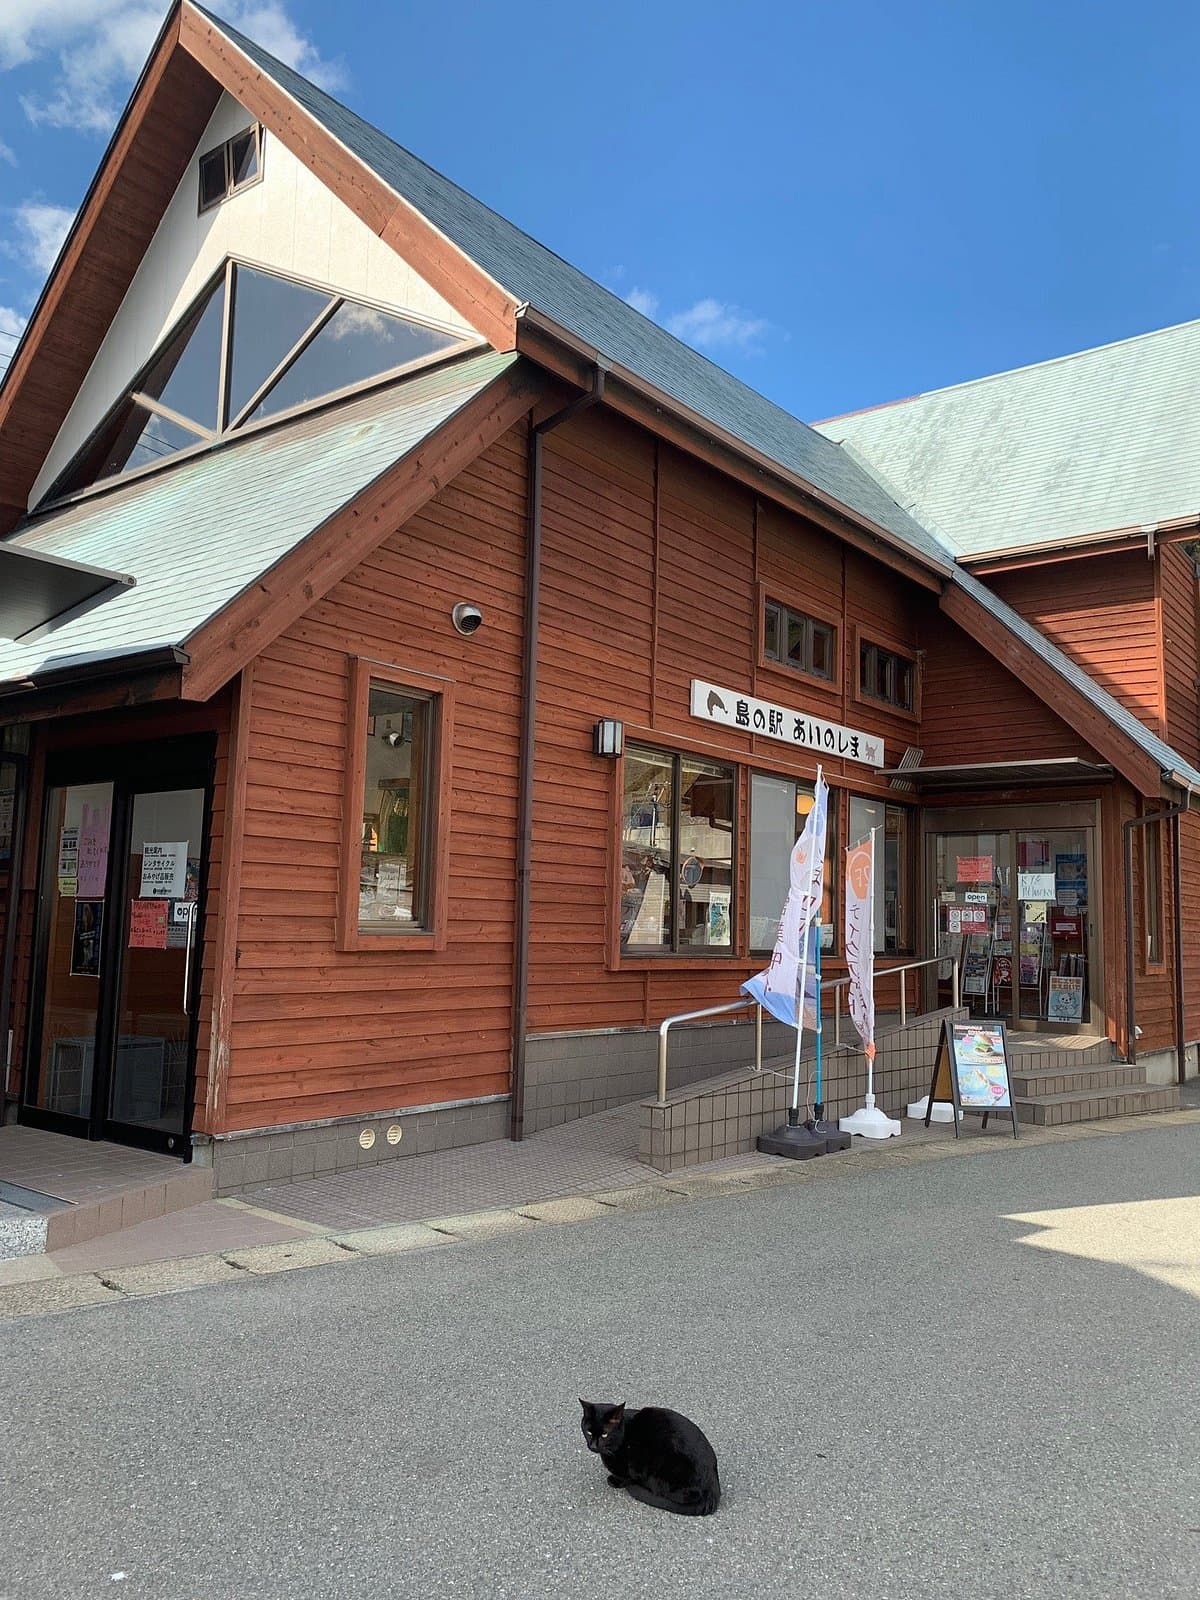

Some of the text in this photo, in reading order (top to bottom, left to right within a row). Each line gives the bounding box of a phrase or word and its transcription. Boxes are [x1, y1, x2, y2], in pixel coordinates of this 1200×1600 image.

[735, 699, 860, 759] 島の駅 あいのしま
[143, 860, 176, 868] レンタサイクル
[967, 894, 986, 904] open
